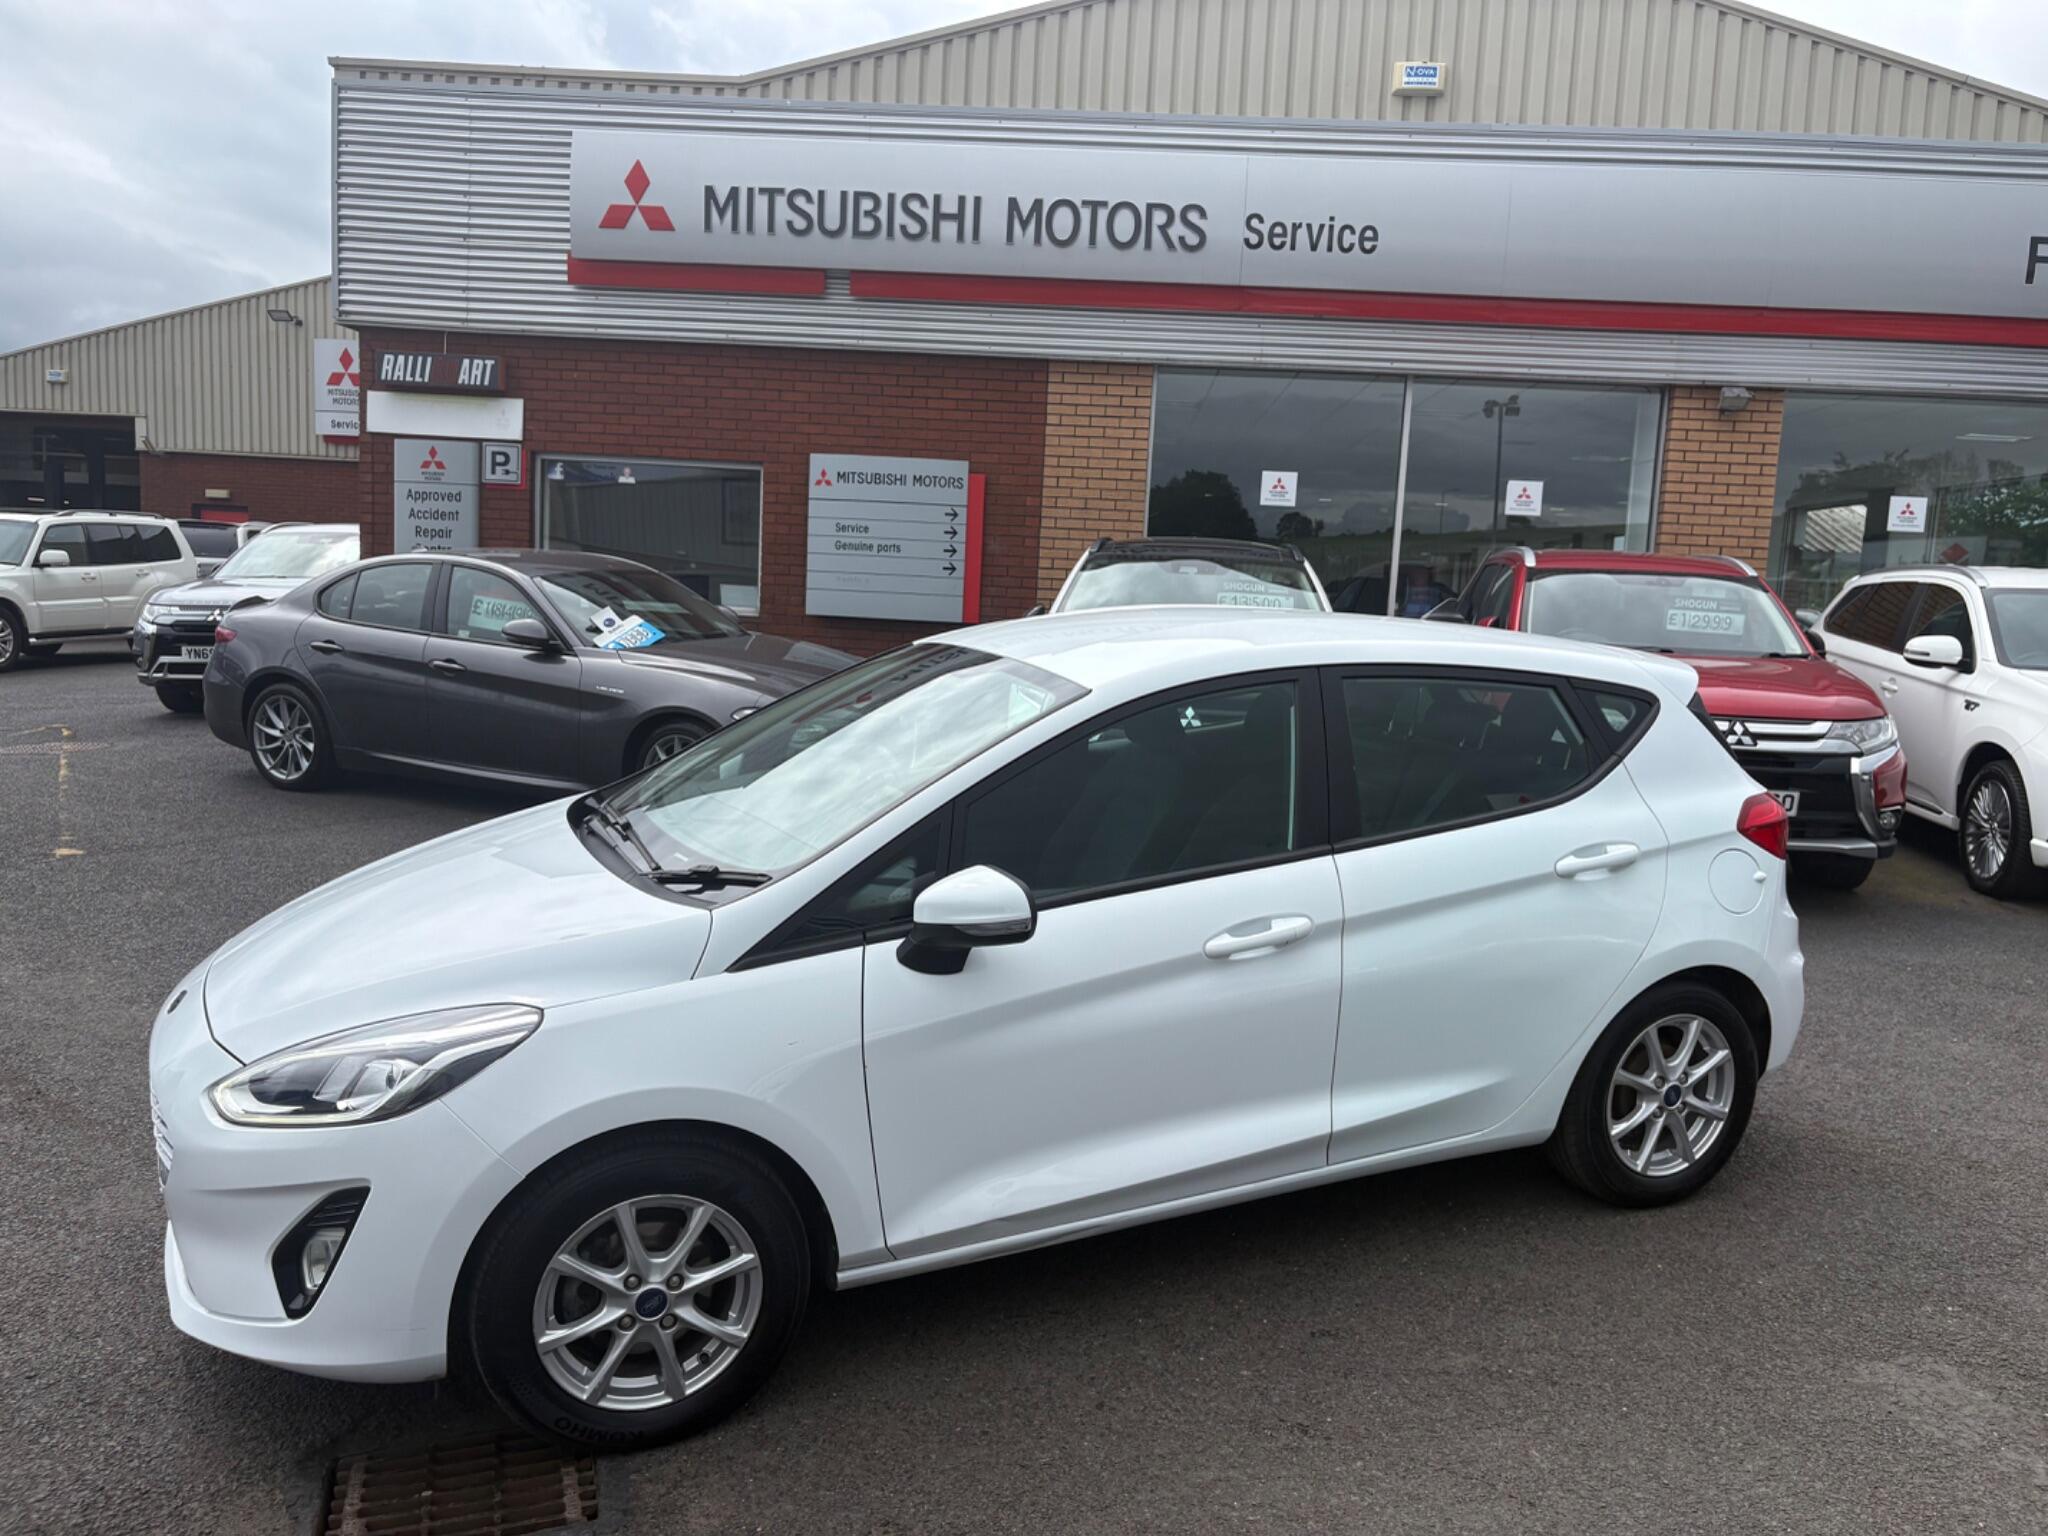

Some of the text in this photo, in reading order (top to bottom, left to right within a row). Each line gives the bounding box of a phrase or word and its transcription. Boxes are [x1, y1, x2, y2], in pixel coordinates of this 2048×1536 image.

[703, 184, 1379, 255] MITSUBISHI MOTORS Service
[380, 354, 495, 386] RALLI ART
[491, 450, 511, 475] P
[836, 471, 964, 490] MITSUBISHI MOTORS
[406, 488, 462, 503] Approved
[408, 507, 460, 521] Accident
[415, 525, 453, 540] Repair
[835, 522, 870, 534] Service
[834, 540, 902, 554] Genuine parts
[1674, 598, 1718, 610] SHOGUN
